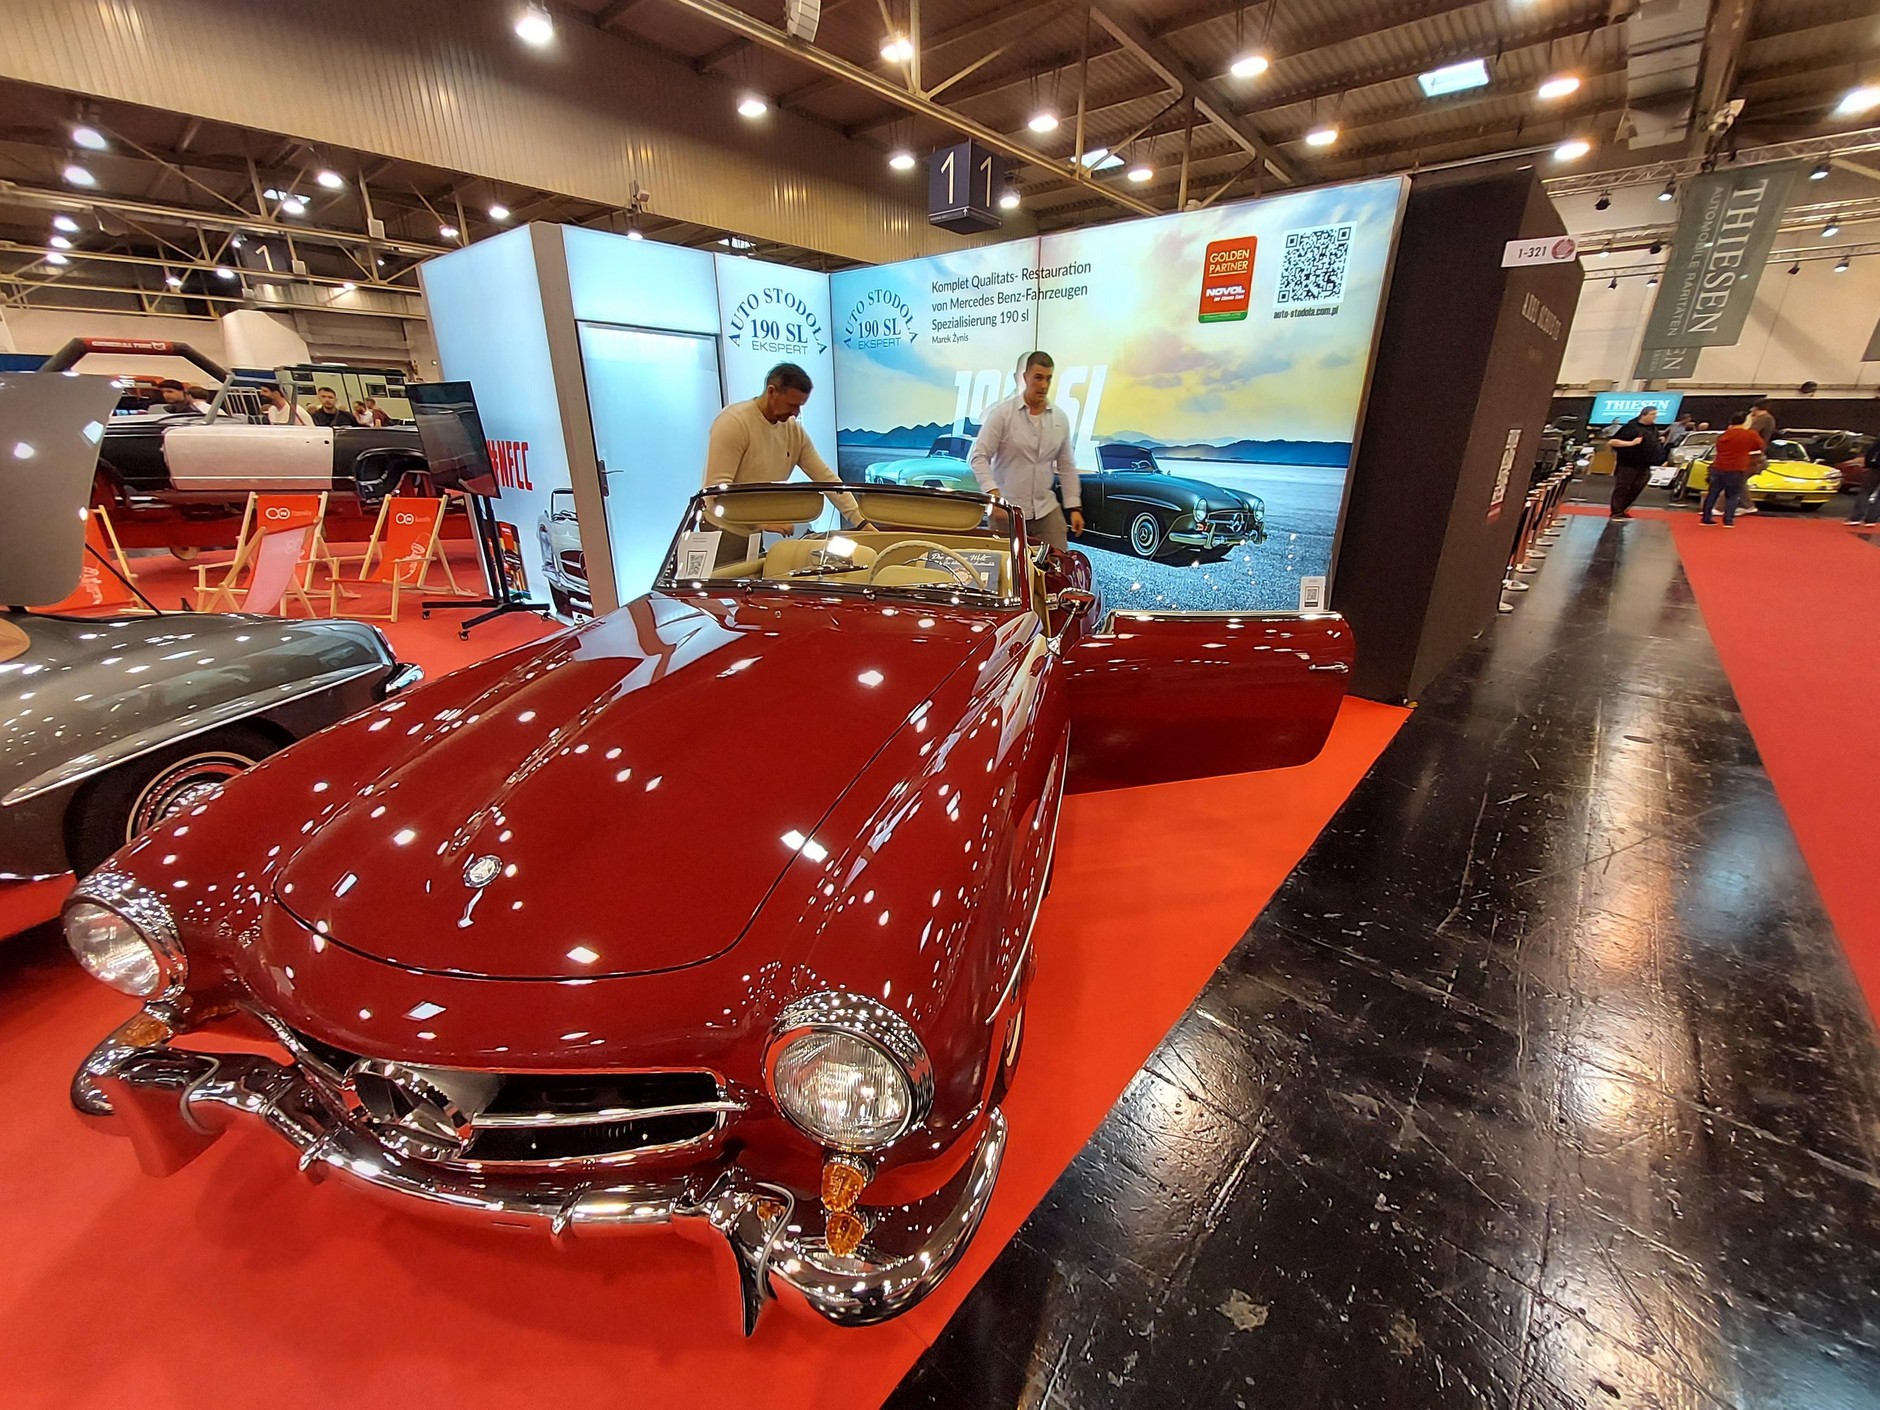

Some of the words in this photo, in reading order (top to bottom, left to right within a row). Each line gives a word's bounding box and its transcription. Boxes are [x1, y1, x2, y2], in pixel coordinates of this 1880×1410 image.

[940, 150, 954, 205] 1
[980, 155, 992, 208] 1
[1689, 186, 1724, 272] AUTOMOBILE
[1210, 249, 1250, 264] GOLDEN
[1518, 246, 1547, 259] 1-321
[1688, 179, 1769, 334] THIESEN
[931, 278, 969, 295] Komplet
[1021, 261, 1092, 282] Restauration
[1209, 260, 1249, 274] PARTNER
[931, 302, 948, 313] von
[949, 294, 995, 311] Mercedes
[997, 284, 1089, 304] Benz-Fahrzeugen
[1206, 285, 1246, 297] NOVOL
[728, 293, 759, 348] AUTO
[931, 313, 998, 333] Spezialisierung
[1000, 312, 1018, 325] 190
[1021, 309, 1029, 323] sl
[1273, 305, 1340, 319] auto-stodola.com.pl
[751, 319, 780, 340] 190
[786, 322, 809, 344] SL
[843, 300, 865, 349] AUTO
[858, 319, 879, 339] 190
[883, 317, 902, 337] SL
[752, 340, 809, 355] EKSPERT
[858, 337, 902, 350] EKSPERT
[931, 334, 952, 344] Marek
[1604, 399, 1671, 410] THIESEN
